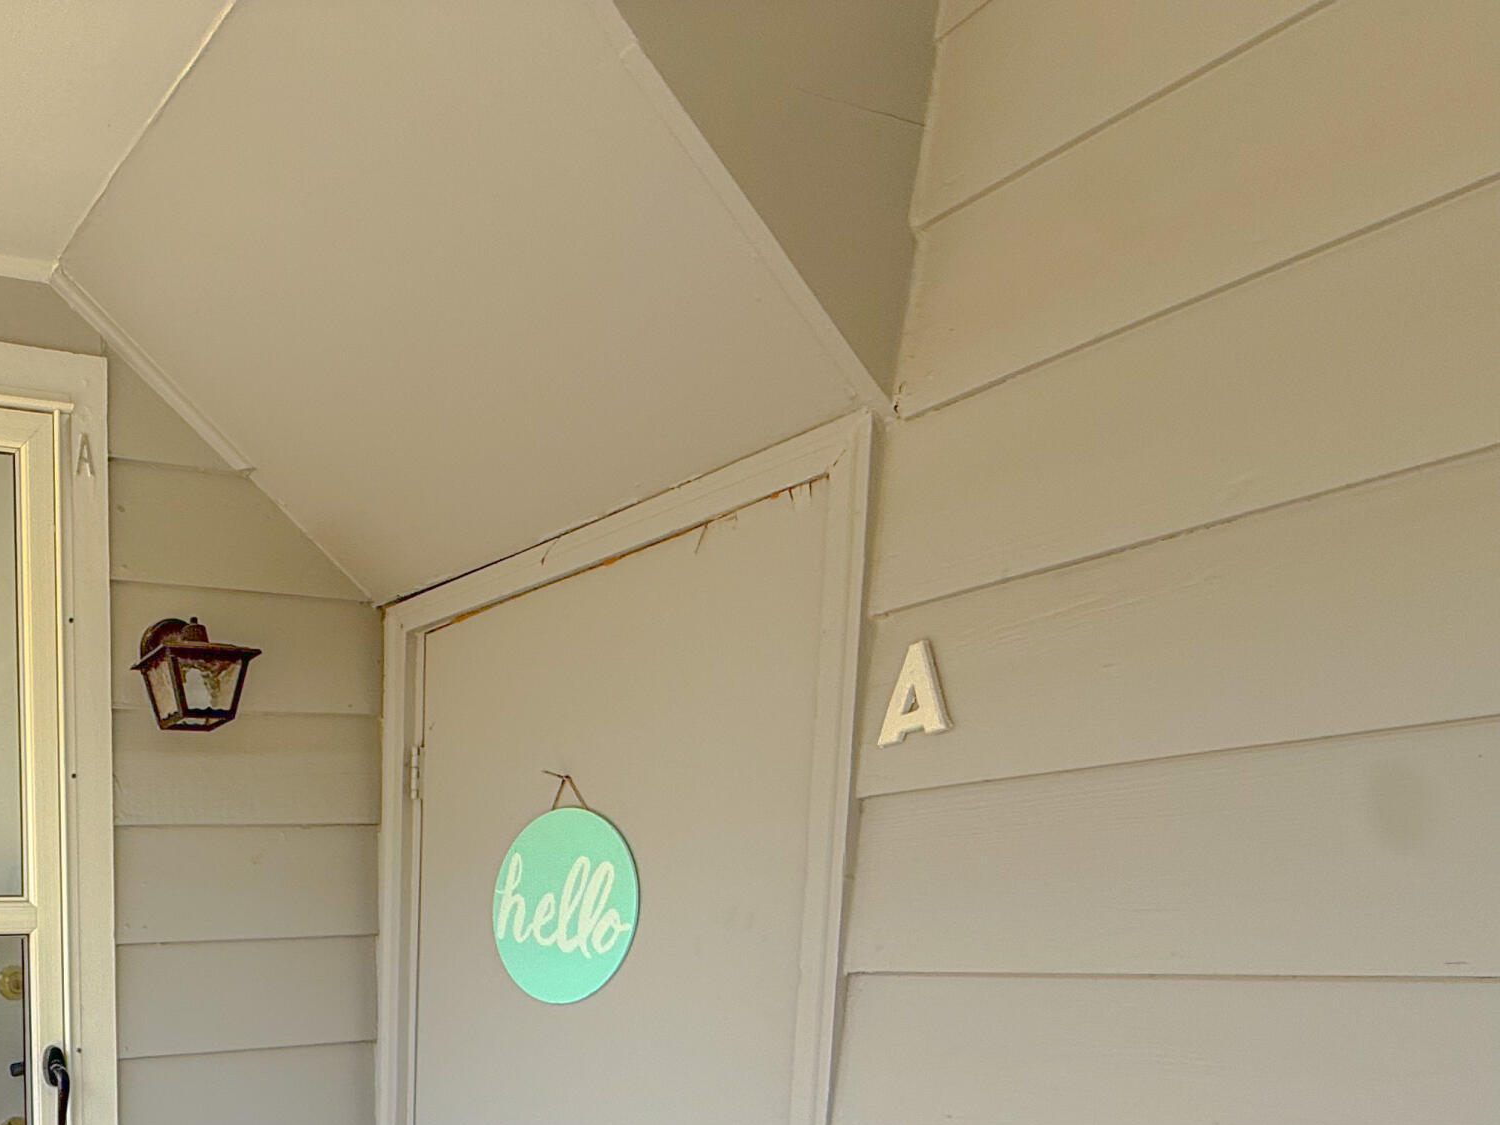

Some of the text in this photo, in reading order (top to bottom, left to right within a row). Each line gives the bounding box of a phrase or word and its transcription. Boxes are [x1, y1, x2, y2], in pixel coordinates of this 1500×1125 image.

[75, 432, 96, 477] A
[877, 640, 952, 748] A
[495, 852, 632, 958] hello
